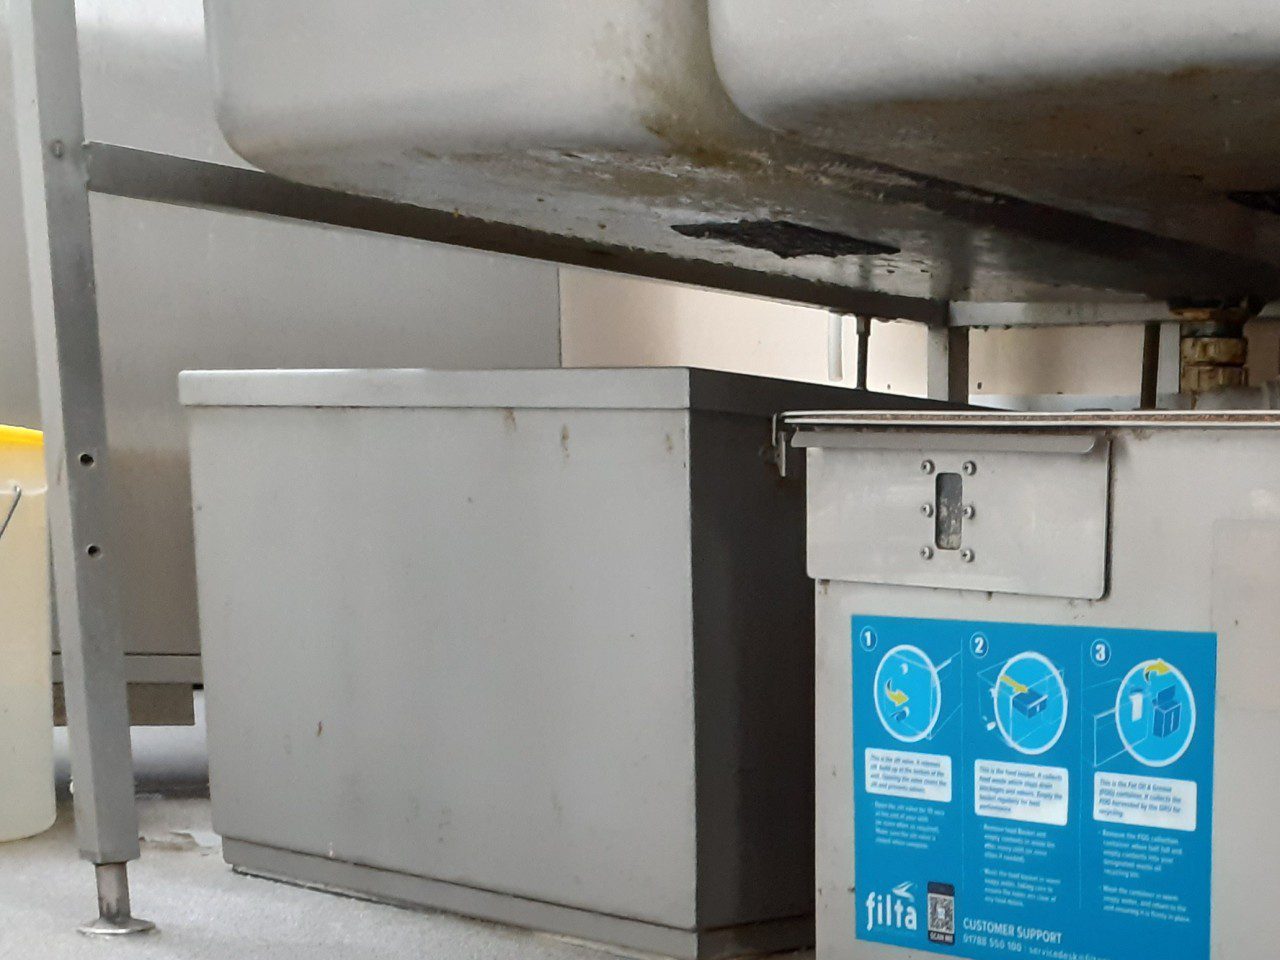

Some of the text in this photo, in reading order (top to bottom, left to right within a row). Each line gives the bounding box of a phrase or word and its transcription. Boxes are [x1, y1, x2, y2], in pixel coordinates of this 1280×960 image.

[864, 631, 872, 646] 1
[974, 636, 984, 653] 2
[1095, 644, 1106, 662] 3
[866, 891, 917, 931] filta
[963, 917, 1062, 944] CUSTOMER SUPPORT
